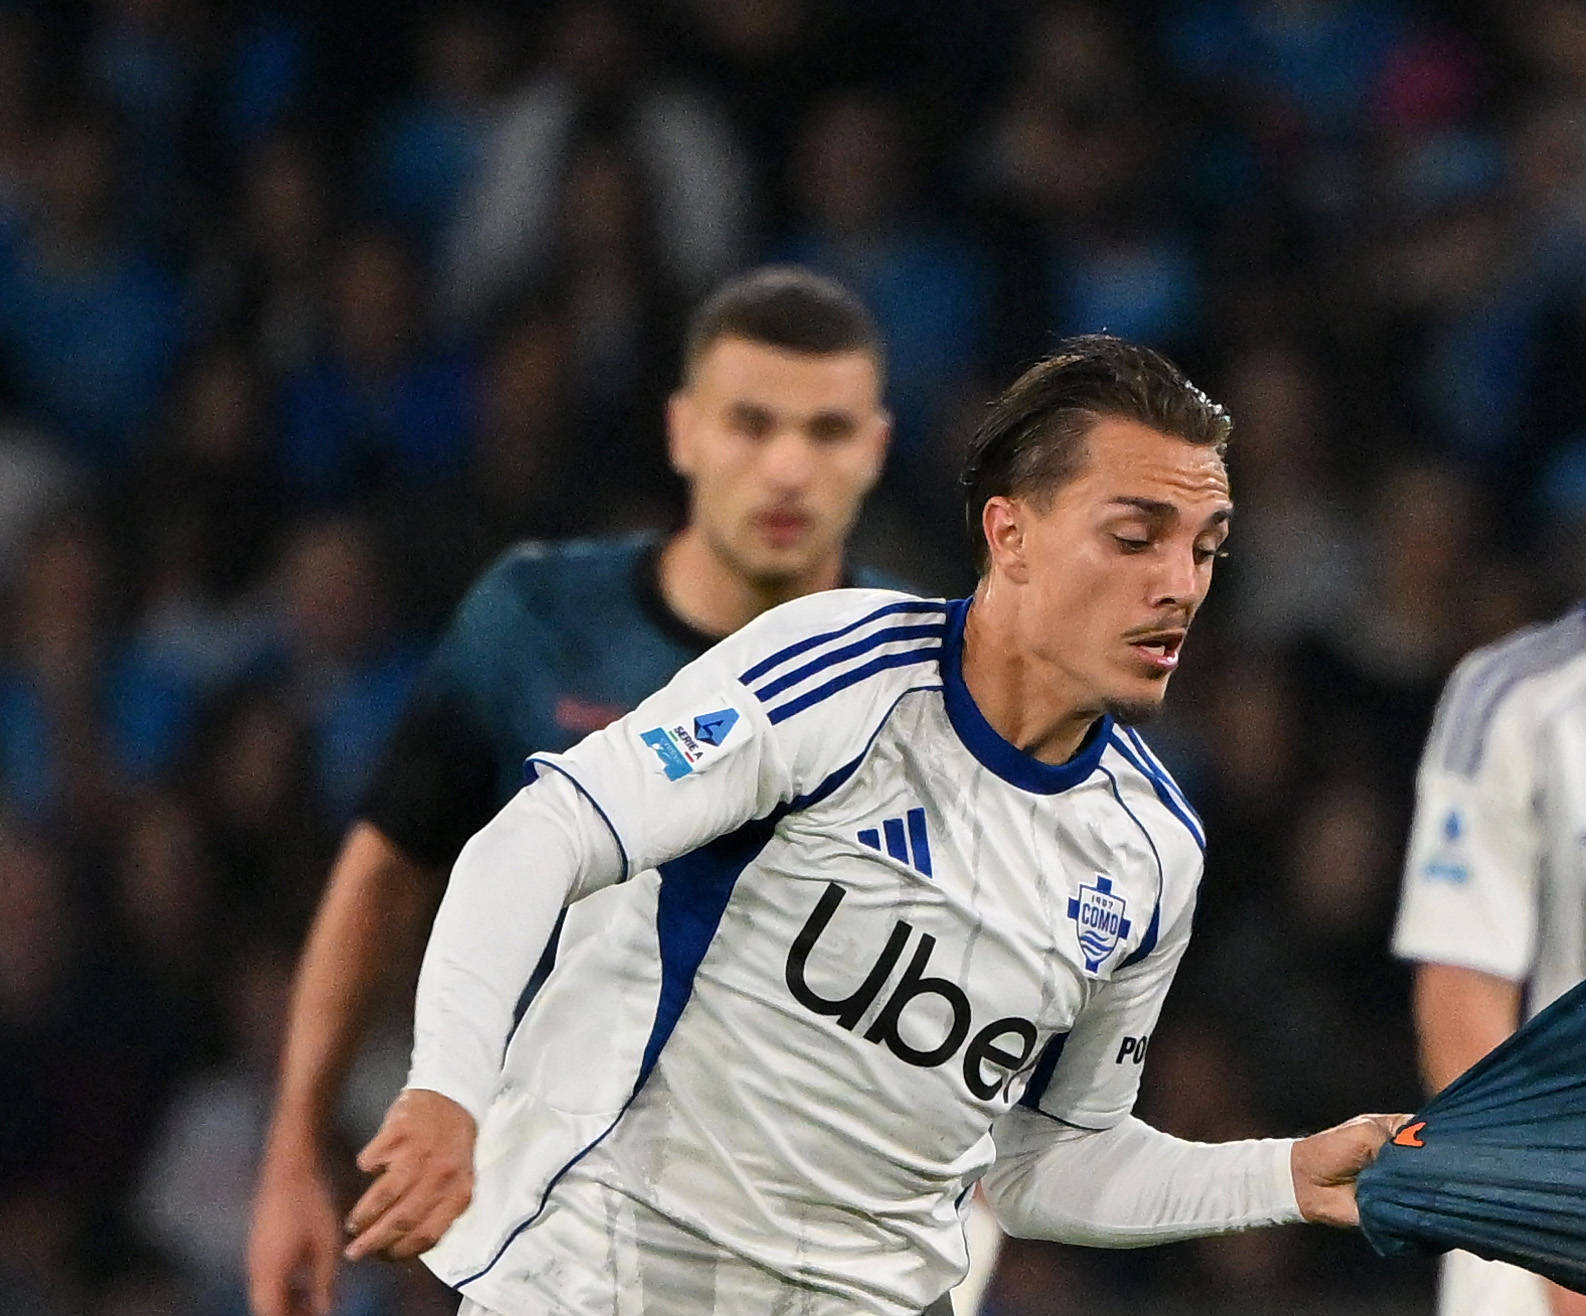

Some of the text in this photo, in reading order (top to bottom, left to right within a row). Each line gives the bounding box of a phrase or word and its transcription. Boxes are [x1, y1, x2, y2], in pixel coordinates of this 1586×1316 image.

[674, 726, 704, 760] SERIE A
[1082, 903, 1119, 935] COMO
[785, 881, 1037, 1103] Ube
[1116, 1036, 1147, 1064] PO
